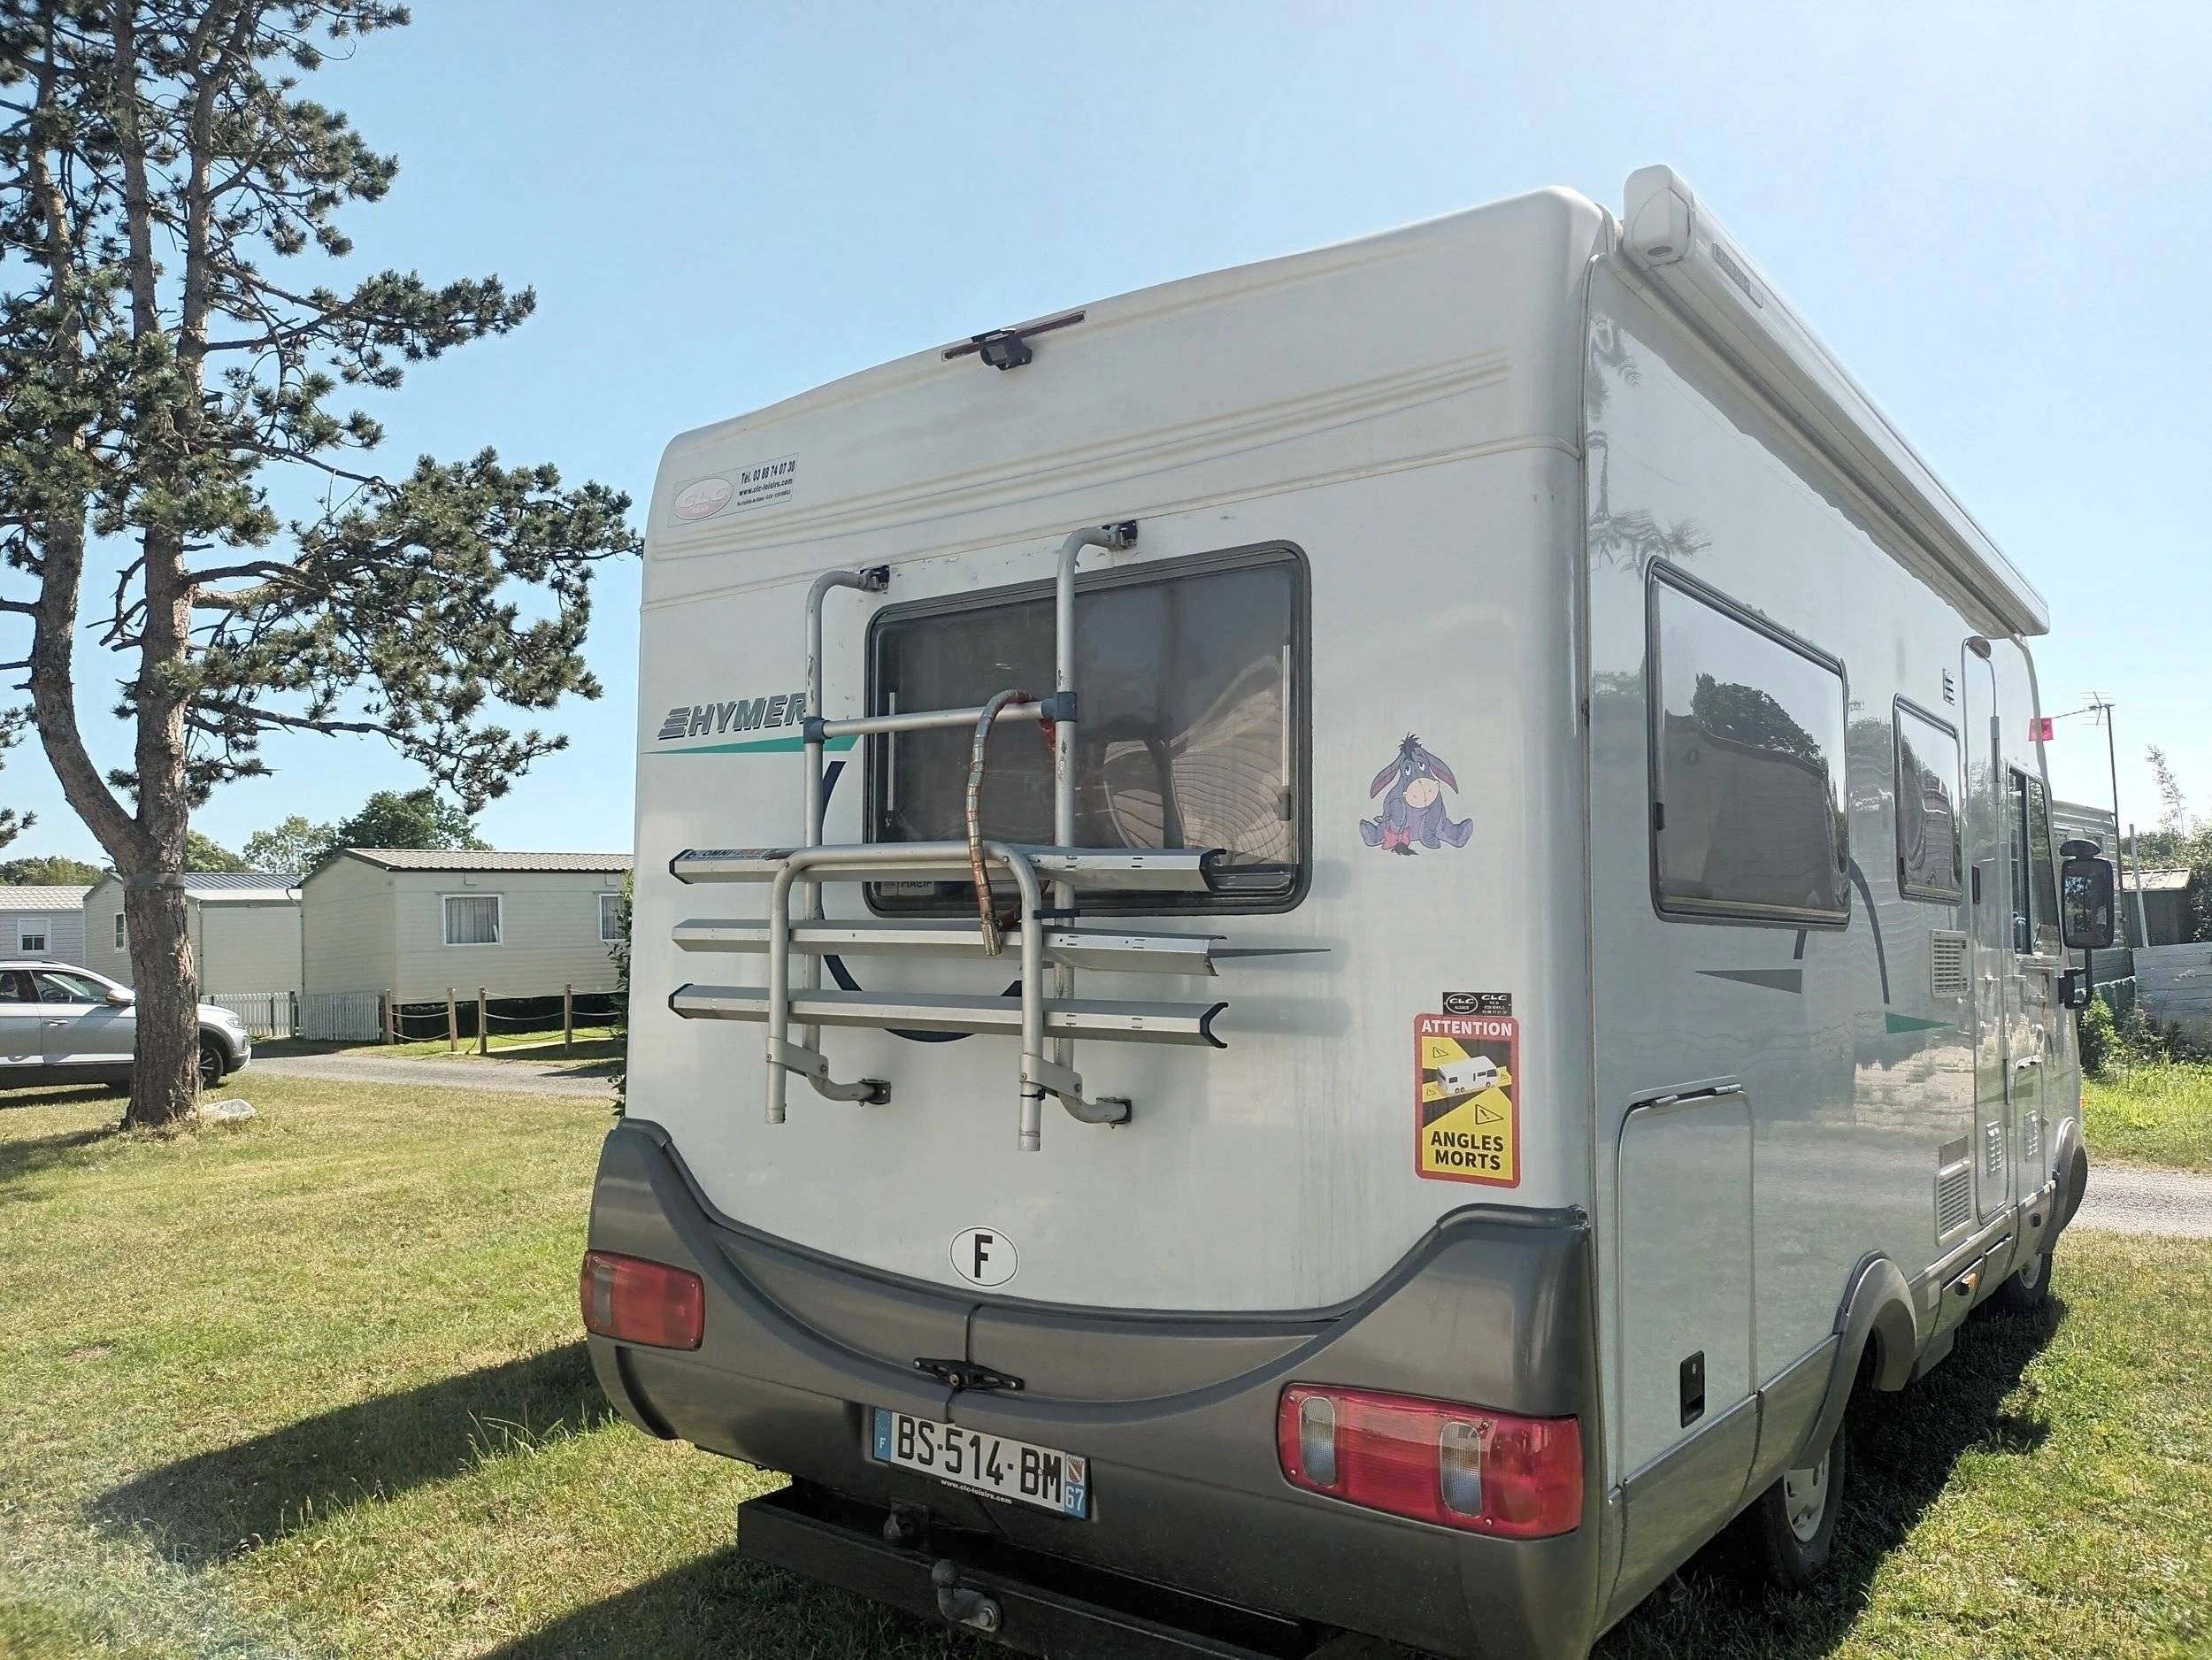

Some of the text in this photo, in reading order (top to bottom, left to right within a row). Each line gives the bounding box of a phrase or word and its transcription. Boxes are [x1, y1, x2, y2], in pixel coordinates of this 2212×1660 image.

[753, 468, 761, 482] 03
[762, 466, 770, 480] 88
[771, 465, 779, 478] 74
[779, 462, 787, 475] 07
[787, 459, 795, 473] 30
[687, 692, 807, 736] HYMER
[1421, 1019, 1512, 1037] ATTENTION
[1431, 1130, 1504, 1152] ANGLES
[1434, 1149, 1502, 1171] MORTS
[974, 1233, 994, 1278] F
[879, 1437, 887, 1449] F
[897, 1414, 1063, 1503] BS-514-BM
[941, 1479, 1013, 1505] www.clc-loisirs.com
[1065, 1485, 1085, 1511] 67
